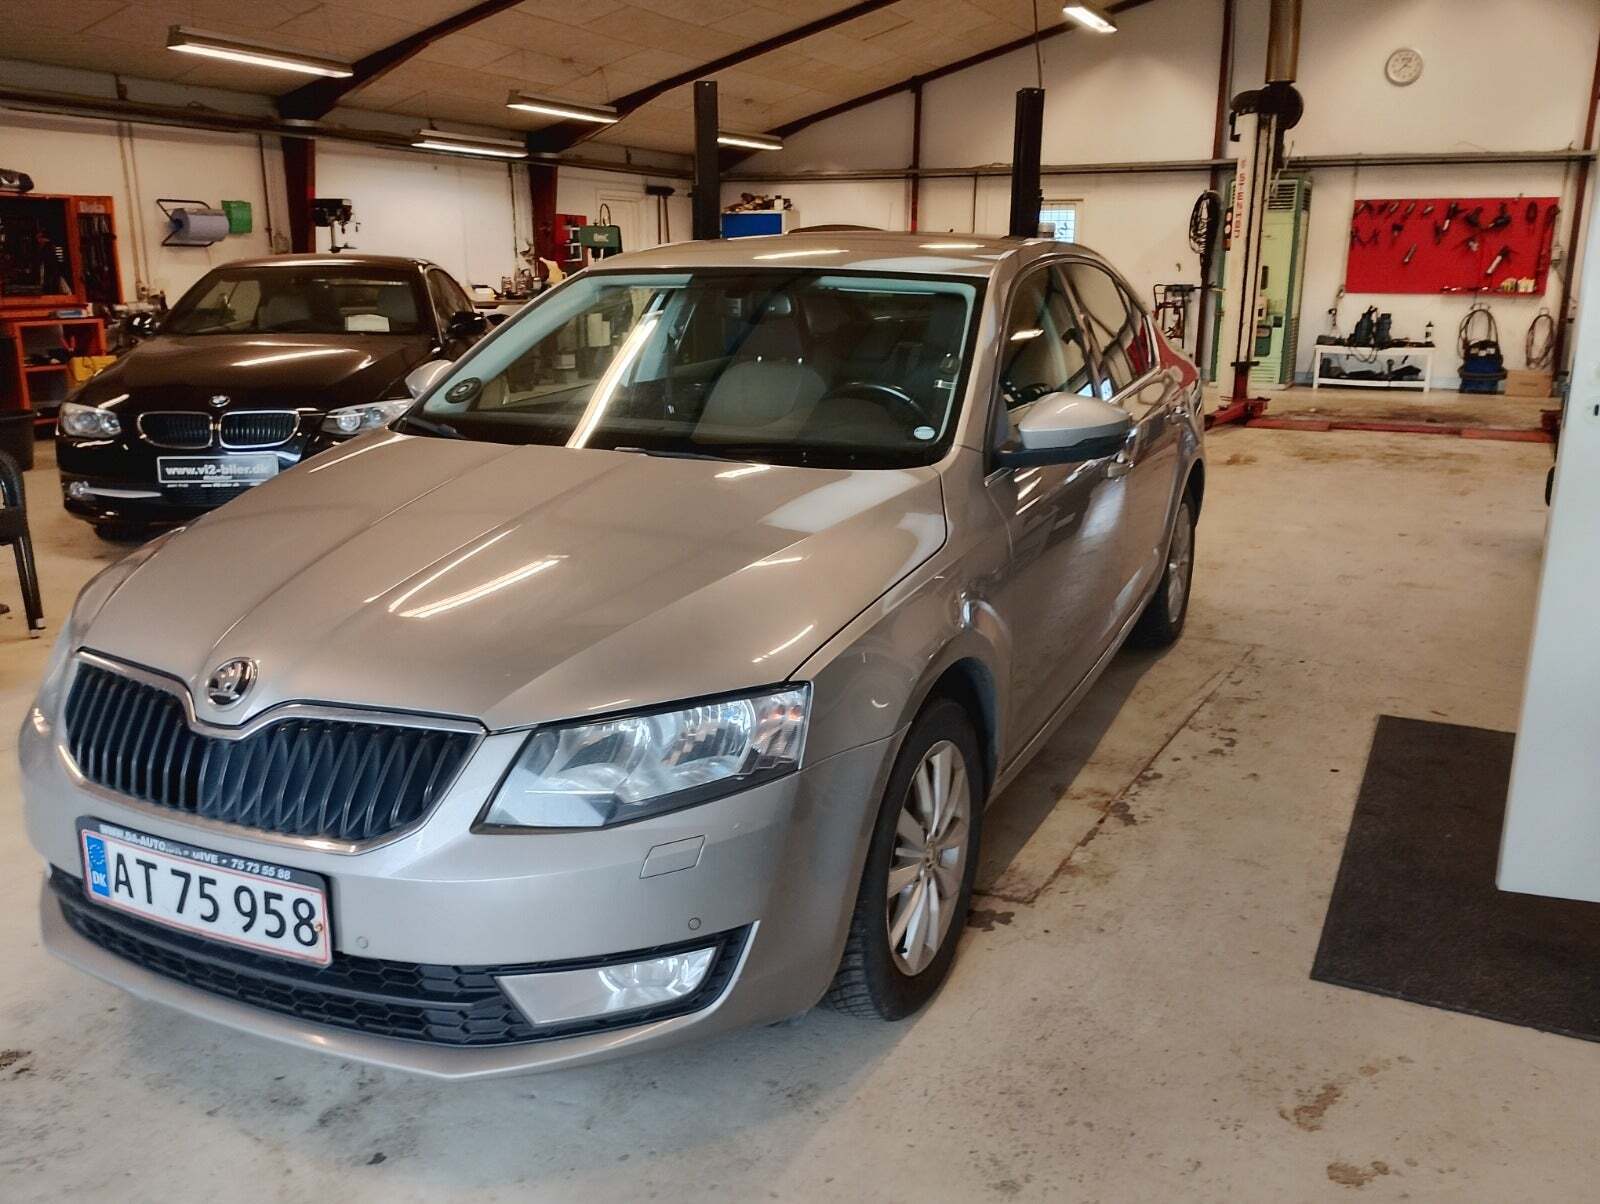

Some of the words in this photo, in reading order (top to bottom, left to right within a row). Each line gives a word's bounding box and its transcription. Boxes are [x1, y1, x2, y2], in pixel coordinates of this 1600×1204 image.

[231, 858, 245, 870] 75
[246, 861, 260, 873] 73
[92, 870, 107, 887] DK
[114, 852, 157, 905] AT
[170, 868, 220, 923] 75
[233, 885, 319, 947] 958
